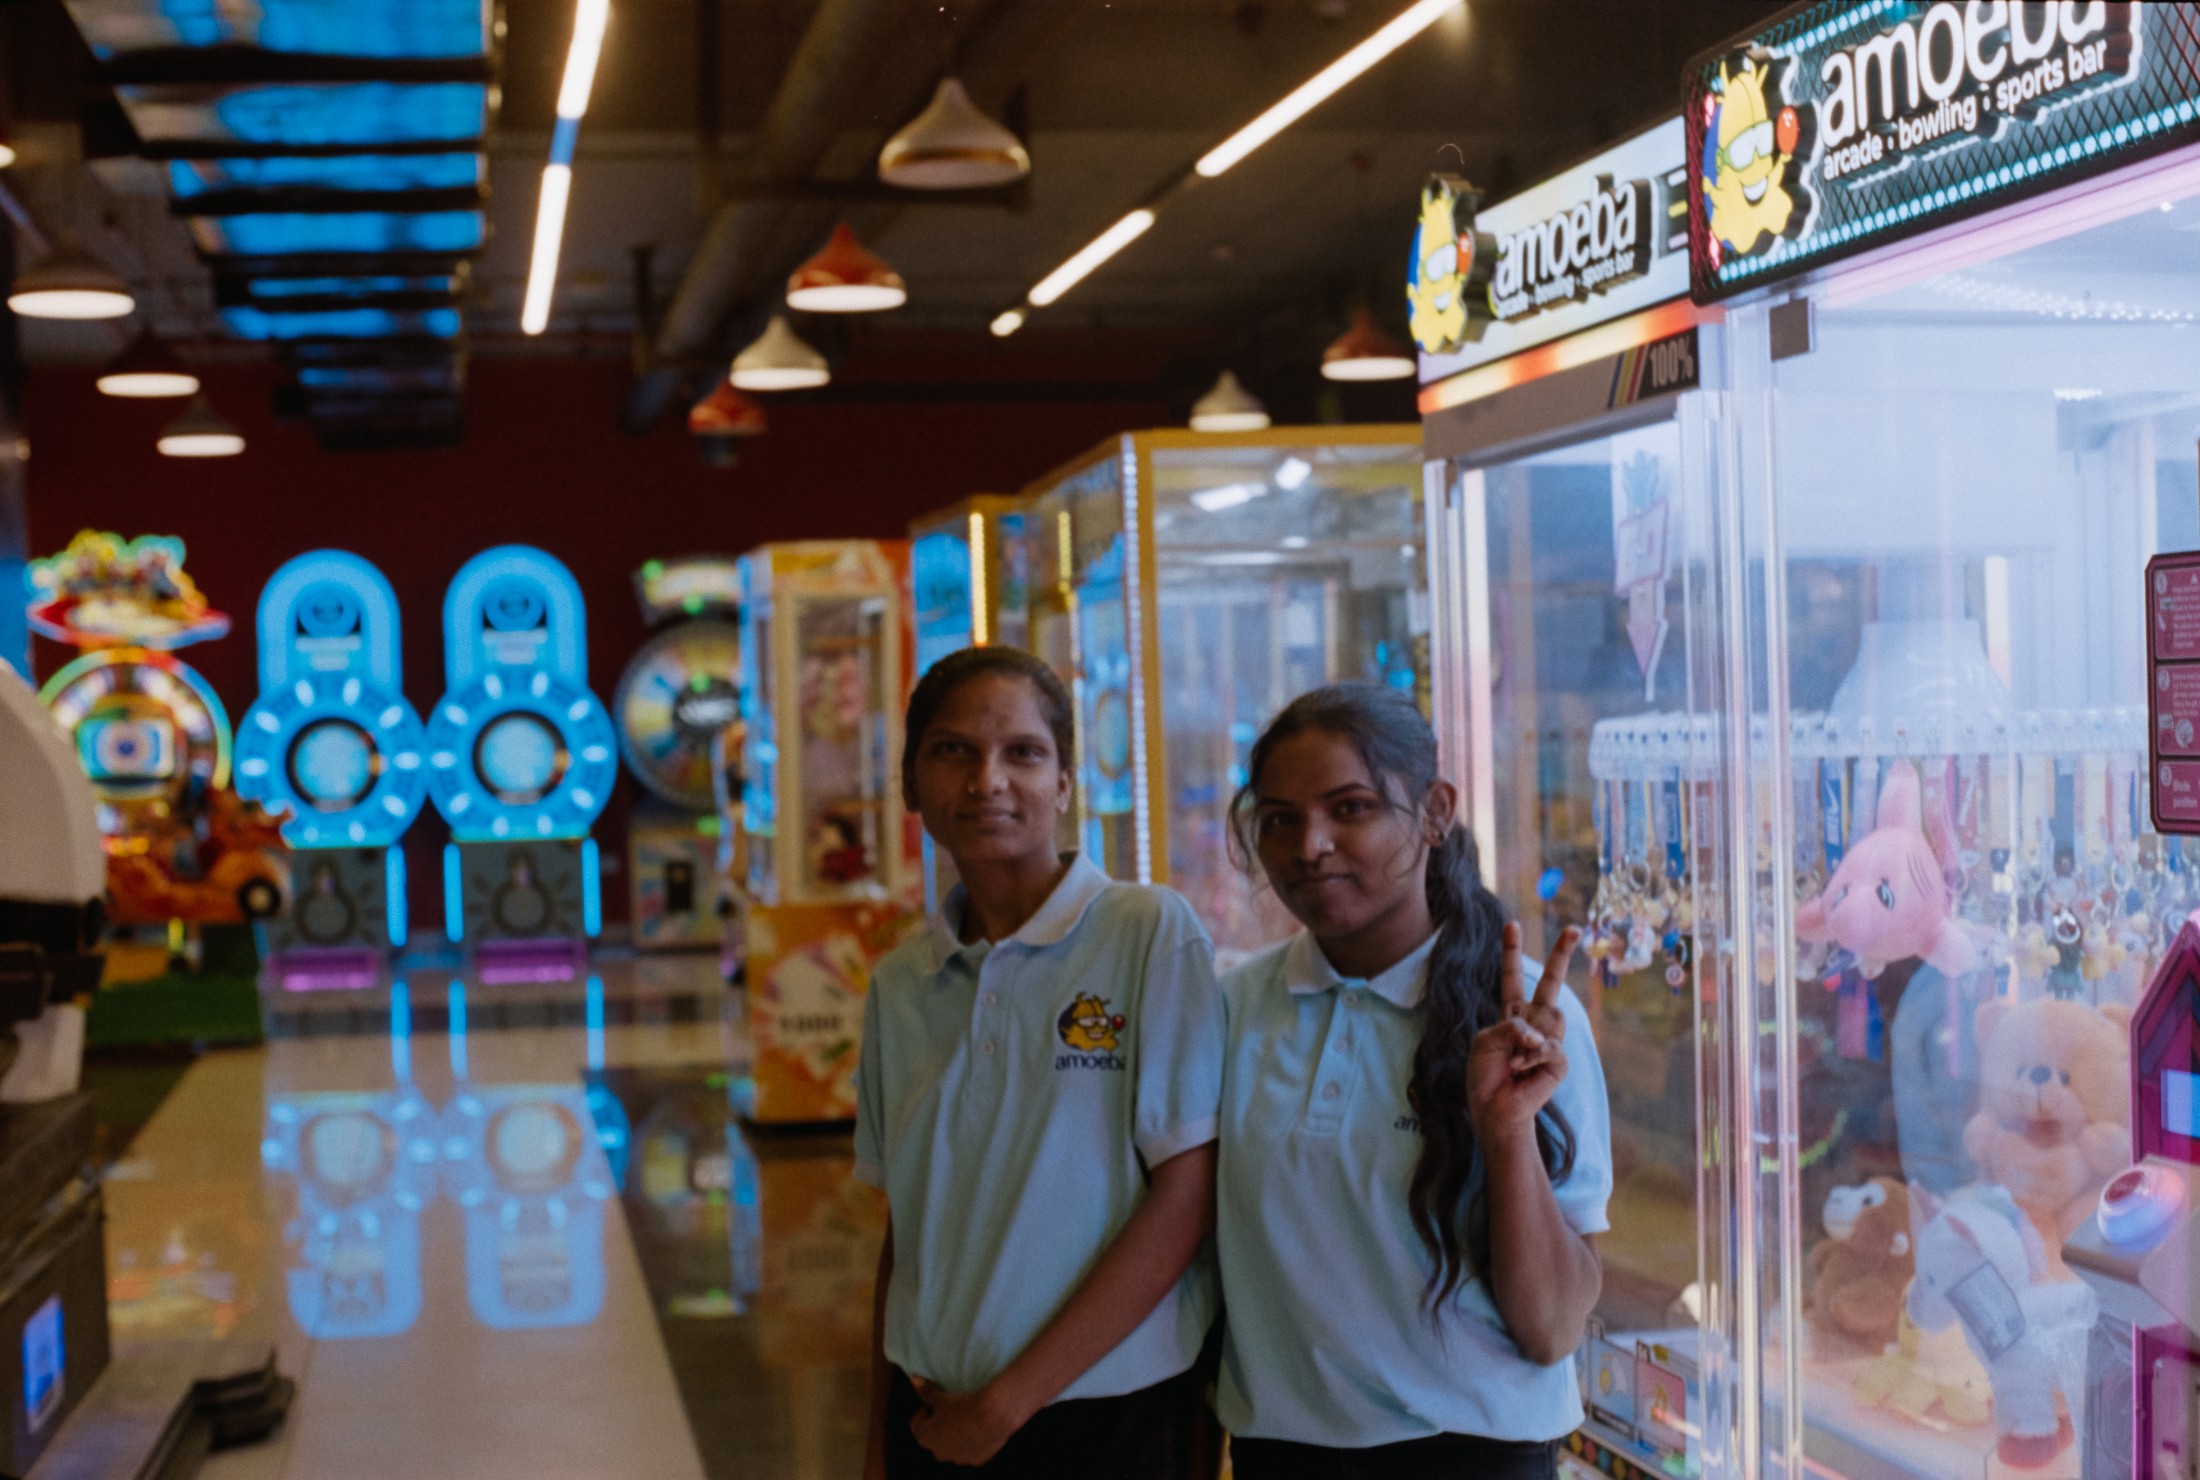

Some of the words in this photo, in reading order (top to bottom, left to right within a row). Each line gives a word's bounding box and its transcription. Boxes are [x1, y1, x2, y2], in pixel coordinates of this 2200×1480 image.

[1823, 134, 1883, 180] arcade
[1898, 94, 1977, 150] bowling
[1996, 56, 2066, 113] sports
[2068, 39, 2107, 81] bar
[1497, 178, 1636, 297] amoeba
[1651, 335, 1694, 387] 100%
